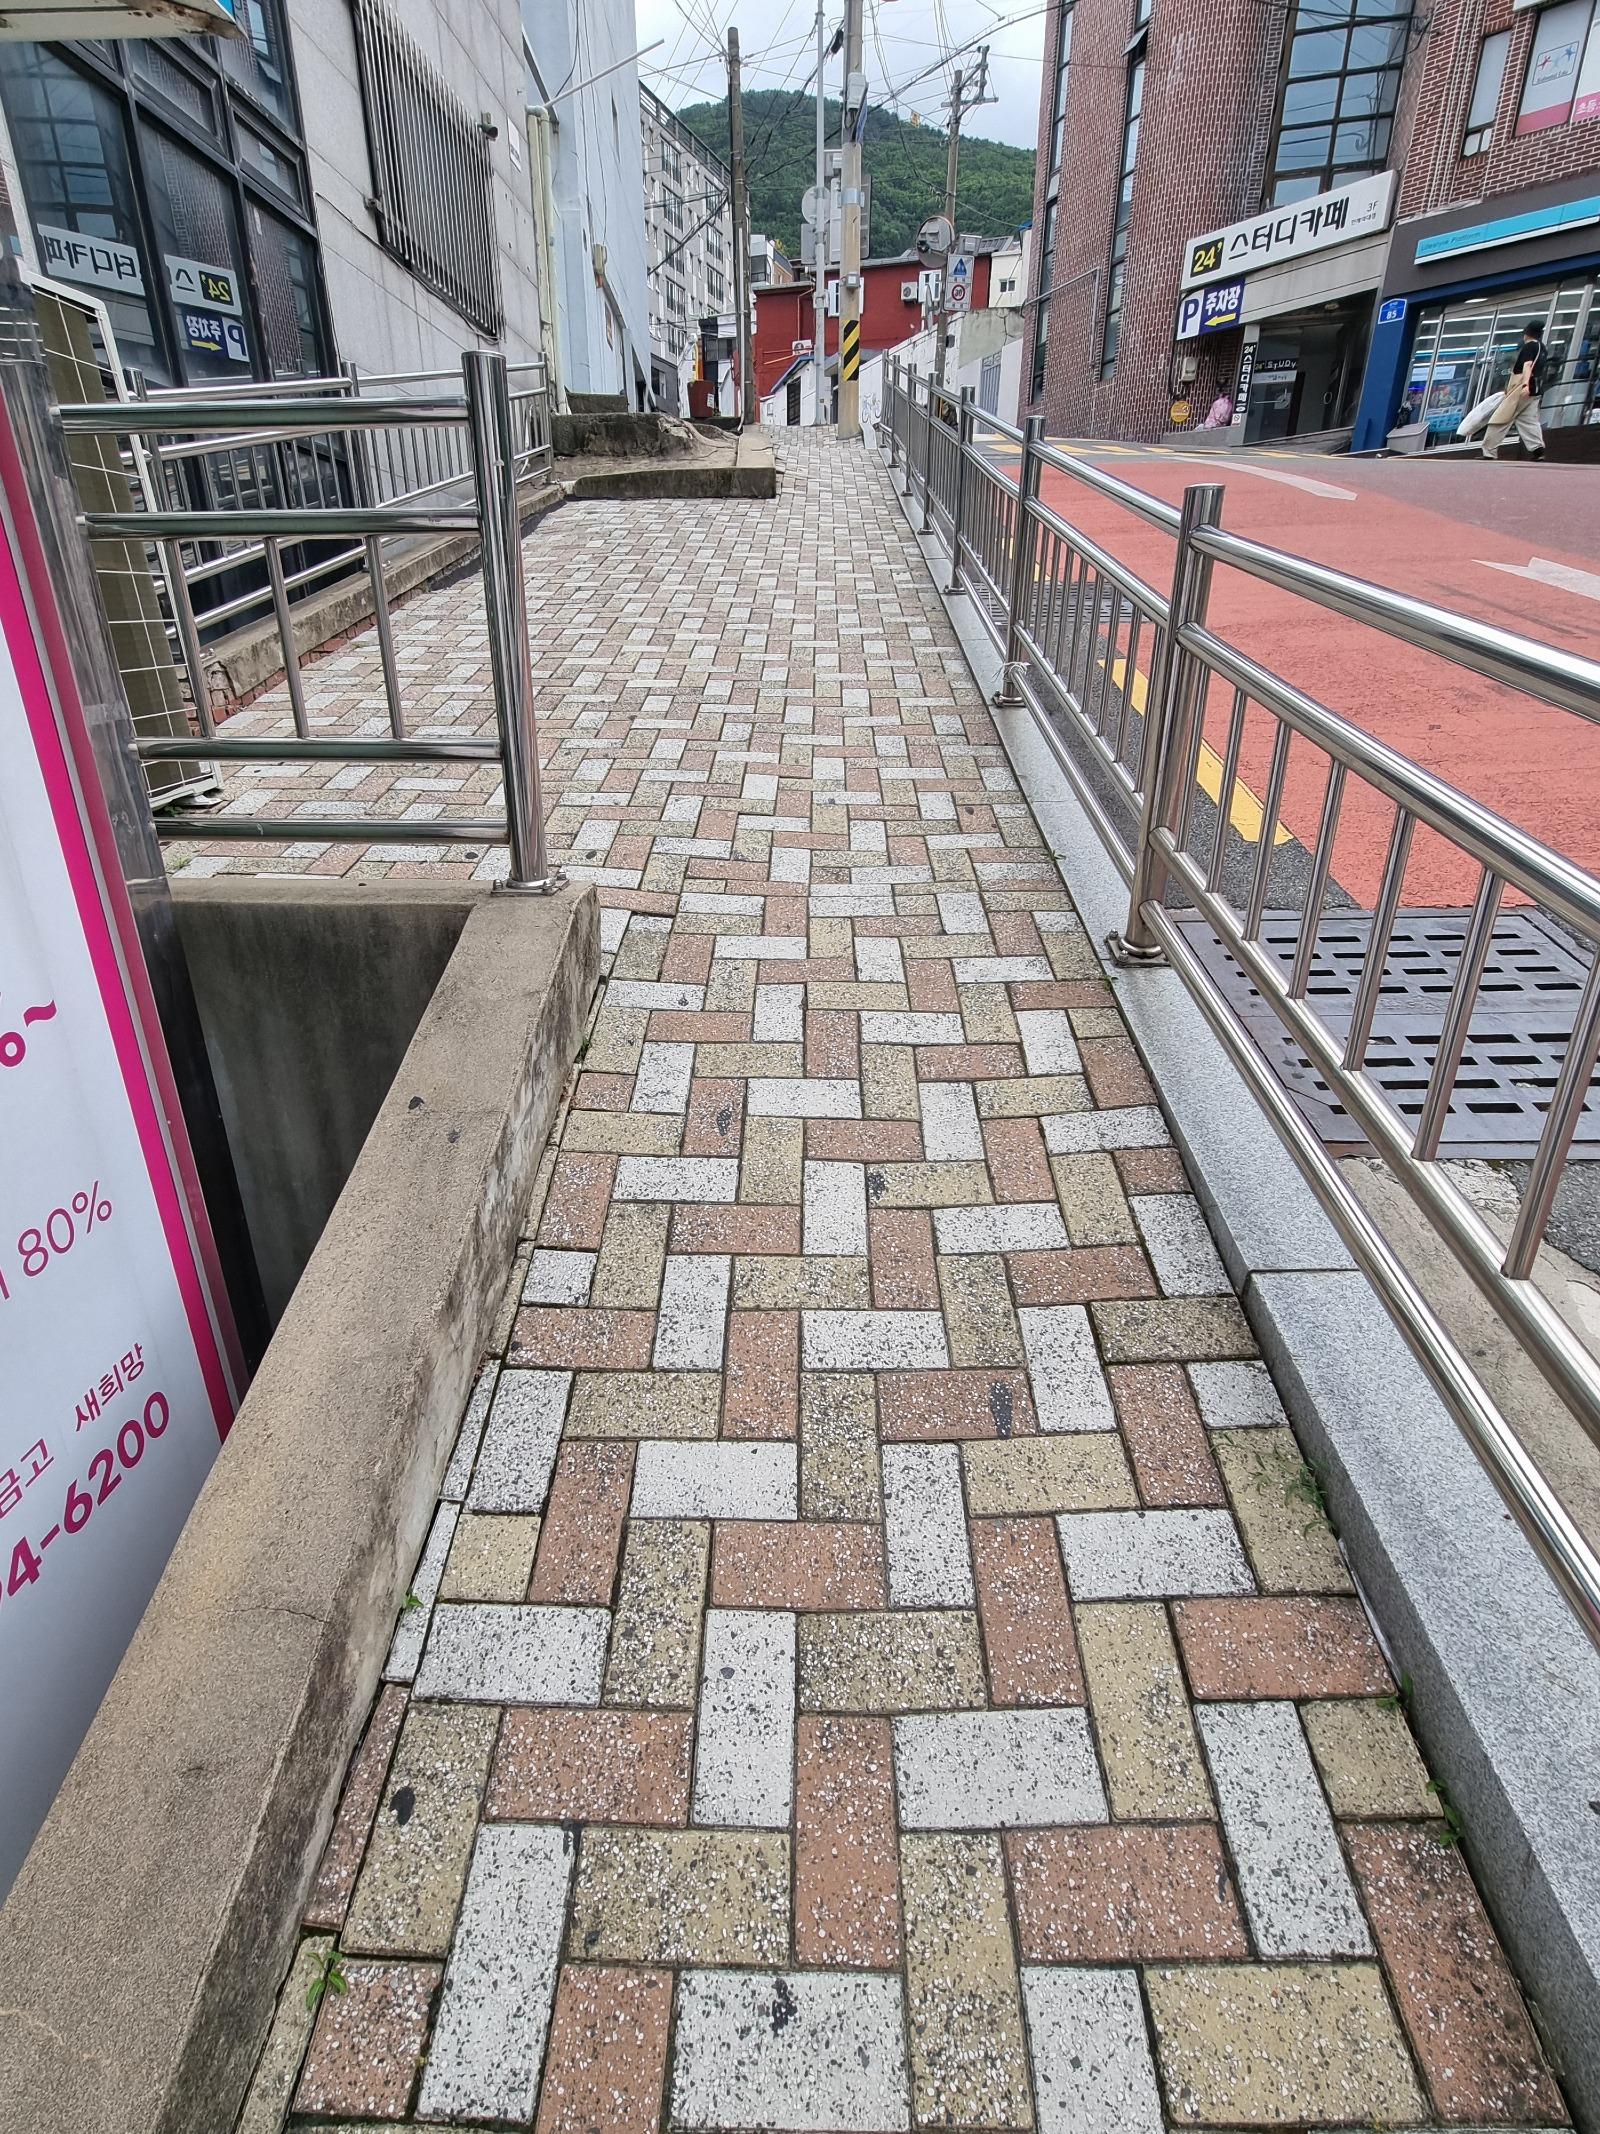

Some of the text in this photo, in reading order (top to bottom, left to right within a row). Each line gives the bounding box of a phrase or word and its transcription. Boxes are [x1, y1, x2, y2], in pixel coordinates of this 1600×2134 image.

[1193, 196, 1350, 274] 24' 스터디카페
[1366, 200, 1379, 212] 3F
[1181, 284, 1242, 334] P 주차장
[1386, 310, 1397, 320] 85
[17, 1180, 112, 1278] 80%
[75, 1342, 144, 1432] 새희망
[0, 1391, 170, 1613] 4-6200
